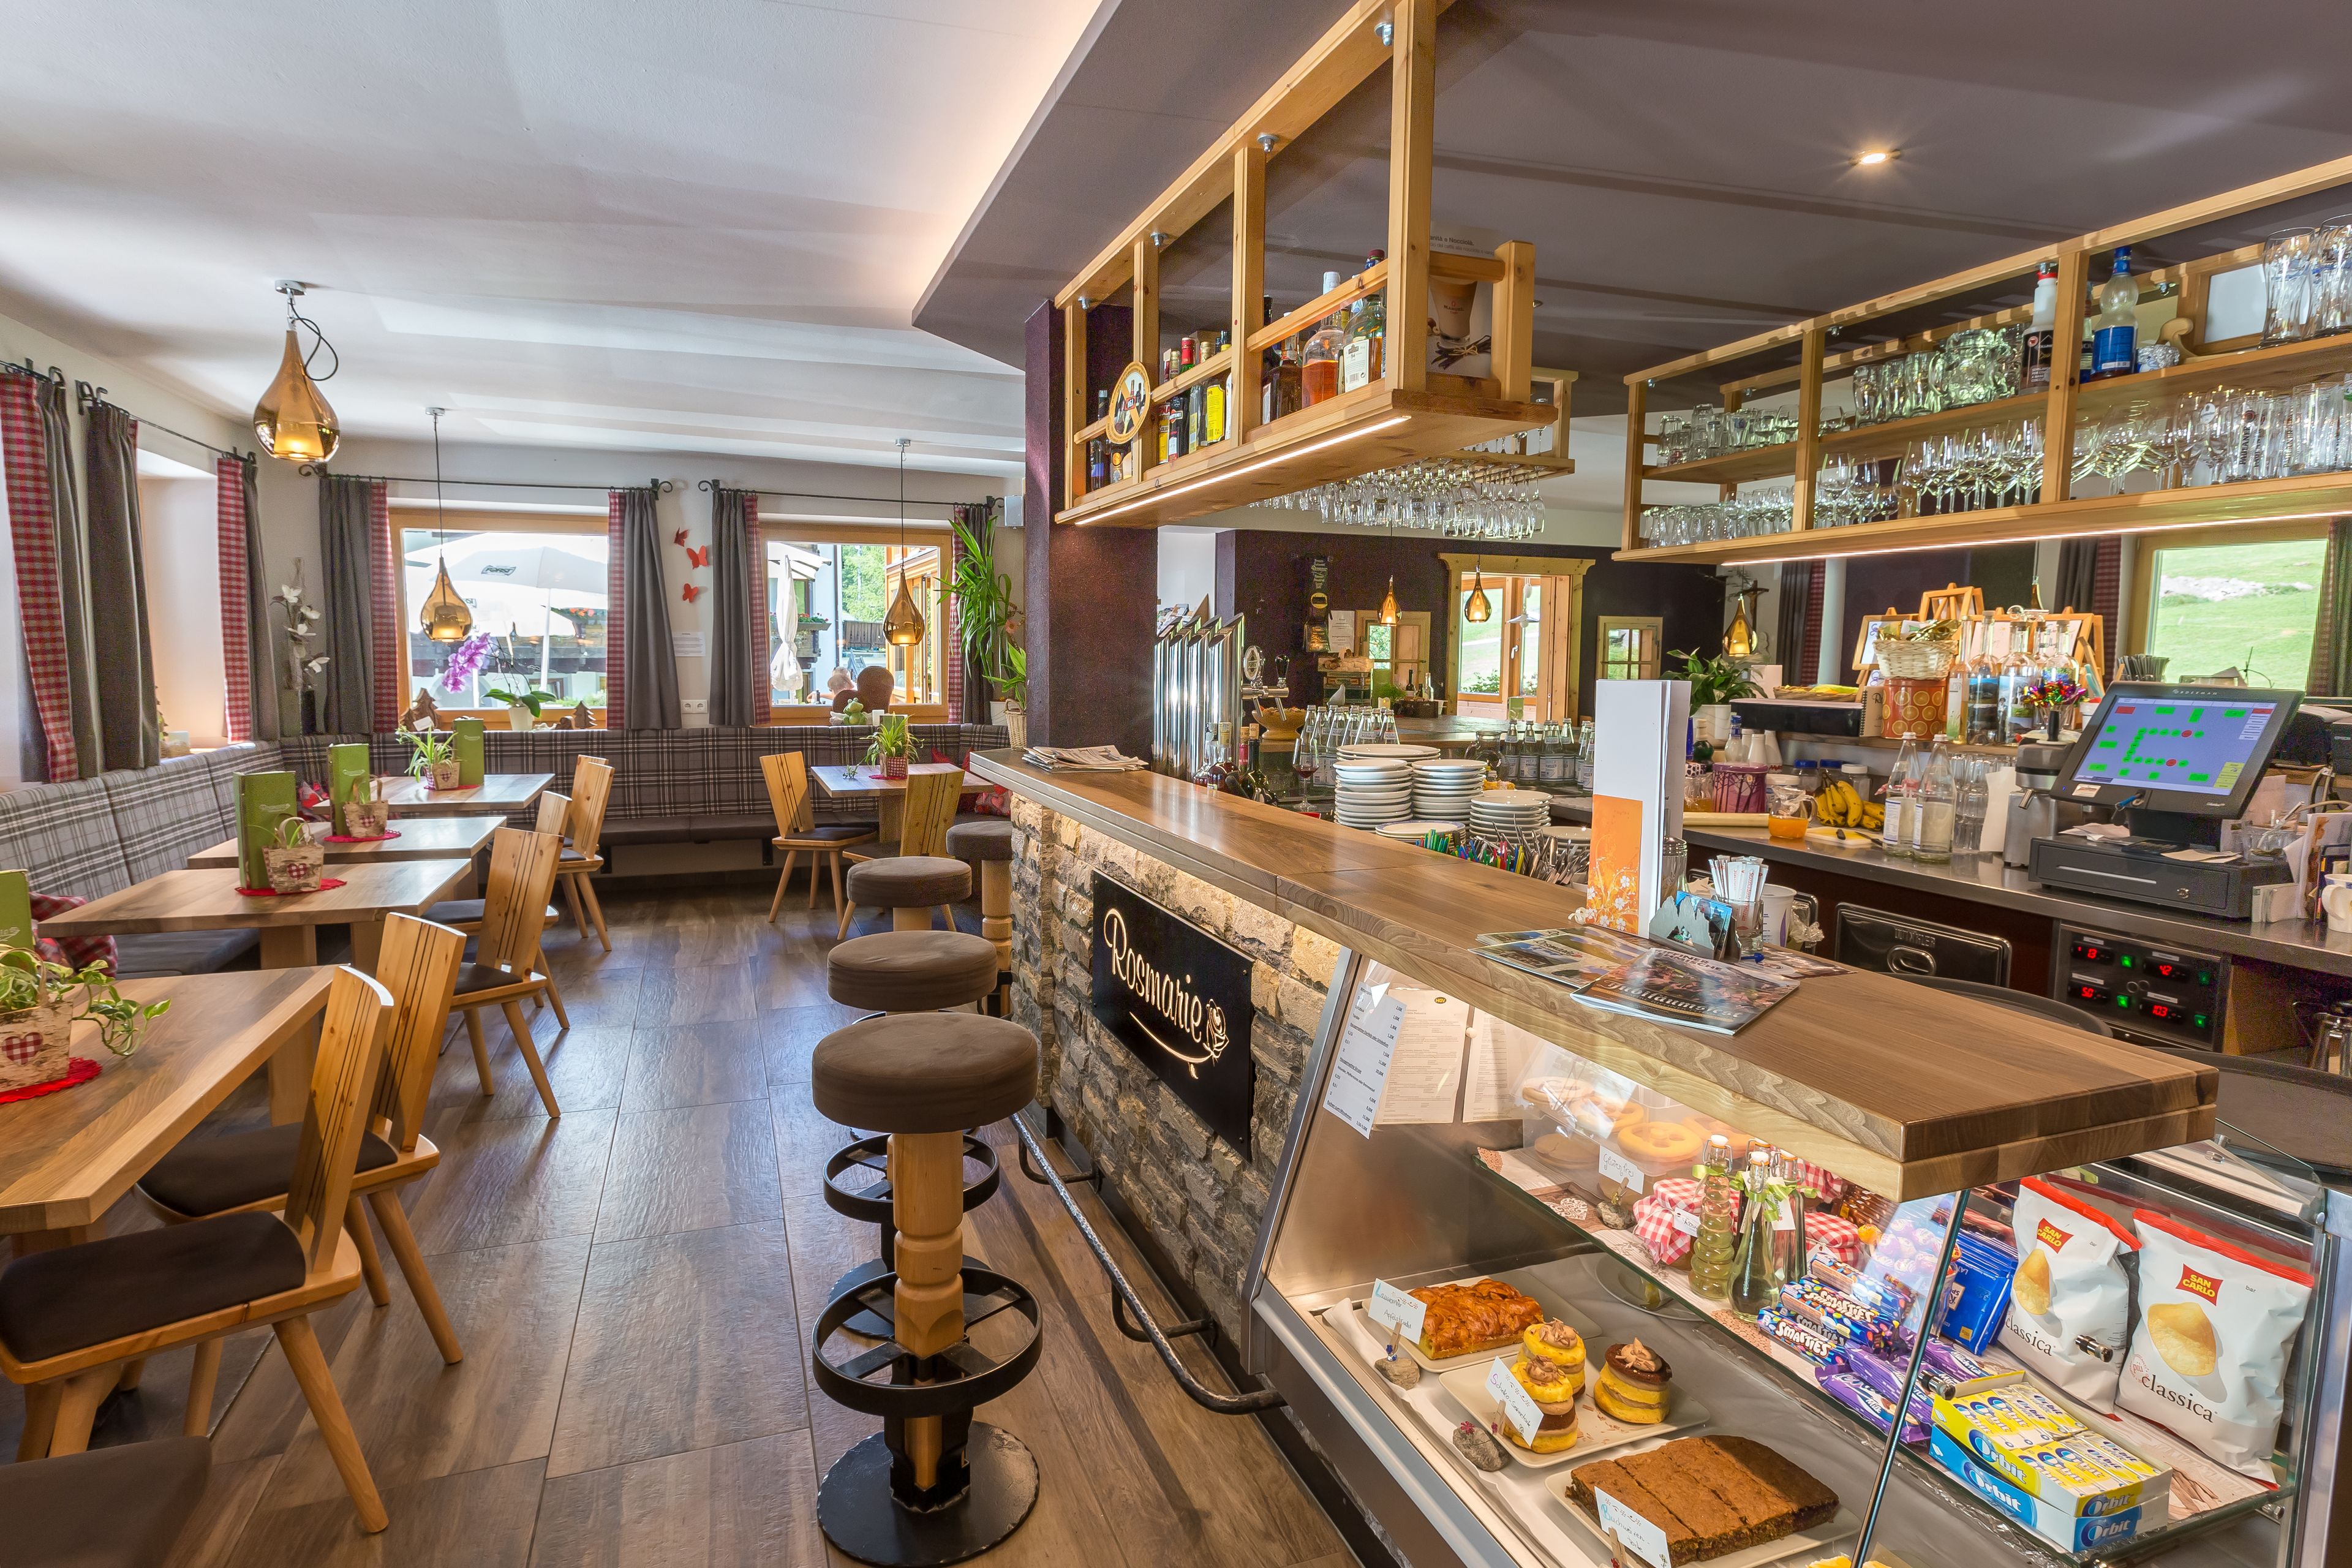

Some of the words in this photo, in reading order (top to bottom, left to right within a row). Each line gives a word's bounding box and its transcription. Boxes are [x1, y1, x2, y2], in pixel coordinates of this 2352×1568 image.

[1104, 908, 1202, 1044] Rosmarie
[2037, 1229, 2062, 1248] CARLO
[2043, 1226, 2062, 1240] SAN
[2182, 1278, 2215, 1298] CARLO
[2190, 1273, 2211, 1288] SAN
[2245, 1285, 2256, 1294] bar
[1775, 1321, 1831, 1358] SMARTIES
[2005, 1315, 2052, 1356] classica
[1987, 1396, 2030, 1428] Orbit
[2016, 1400, 2046, 1420] Orbit
[2141, 1374, 2214, 1423] classica
[1969, 1401, 2013, 1433] Orbit
[1969, 1429, 2027, 1485] Orbit
[2054, 1447, 2106, 1479] Orbit
[2087, 1449, 2122, 1470] Orbit
[2103, 1441, 2139, 1463] Orbit
[2037, 1452, 2087, 1483] Orbit
[1963, 1460, 2021, 1513] Orbit
[2081, 1493, 2134, 1517] Orbit
[2081, 1518, 2130, 1547] Orbit
